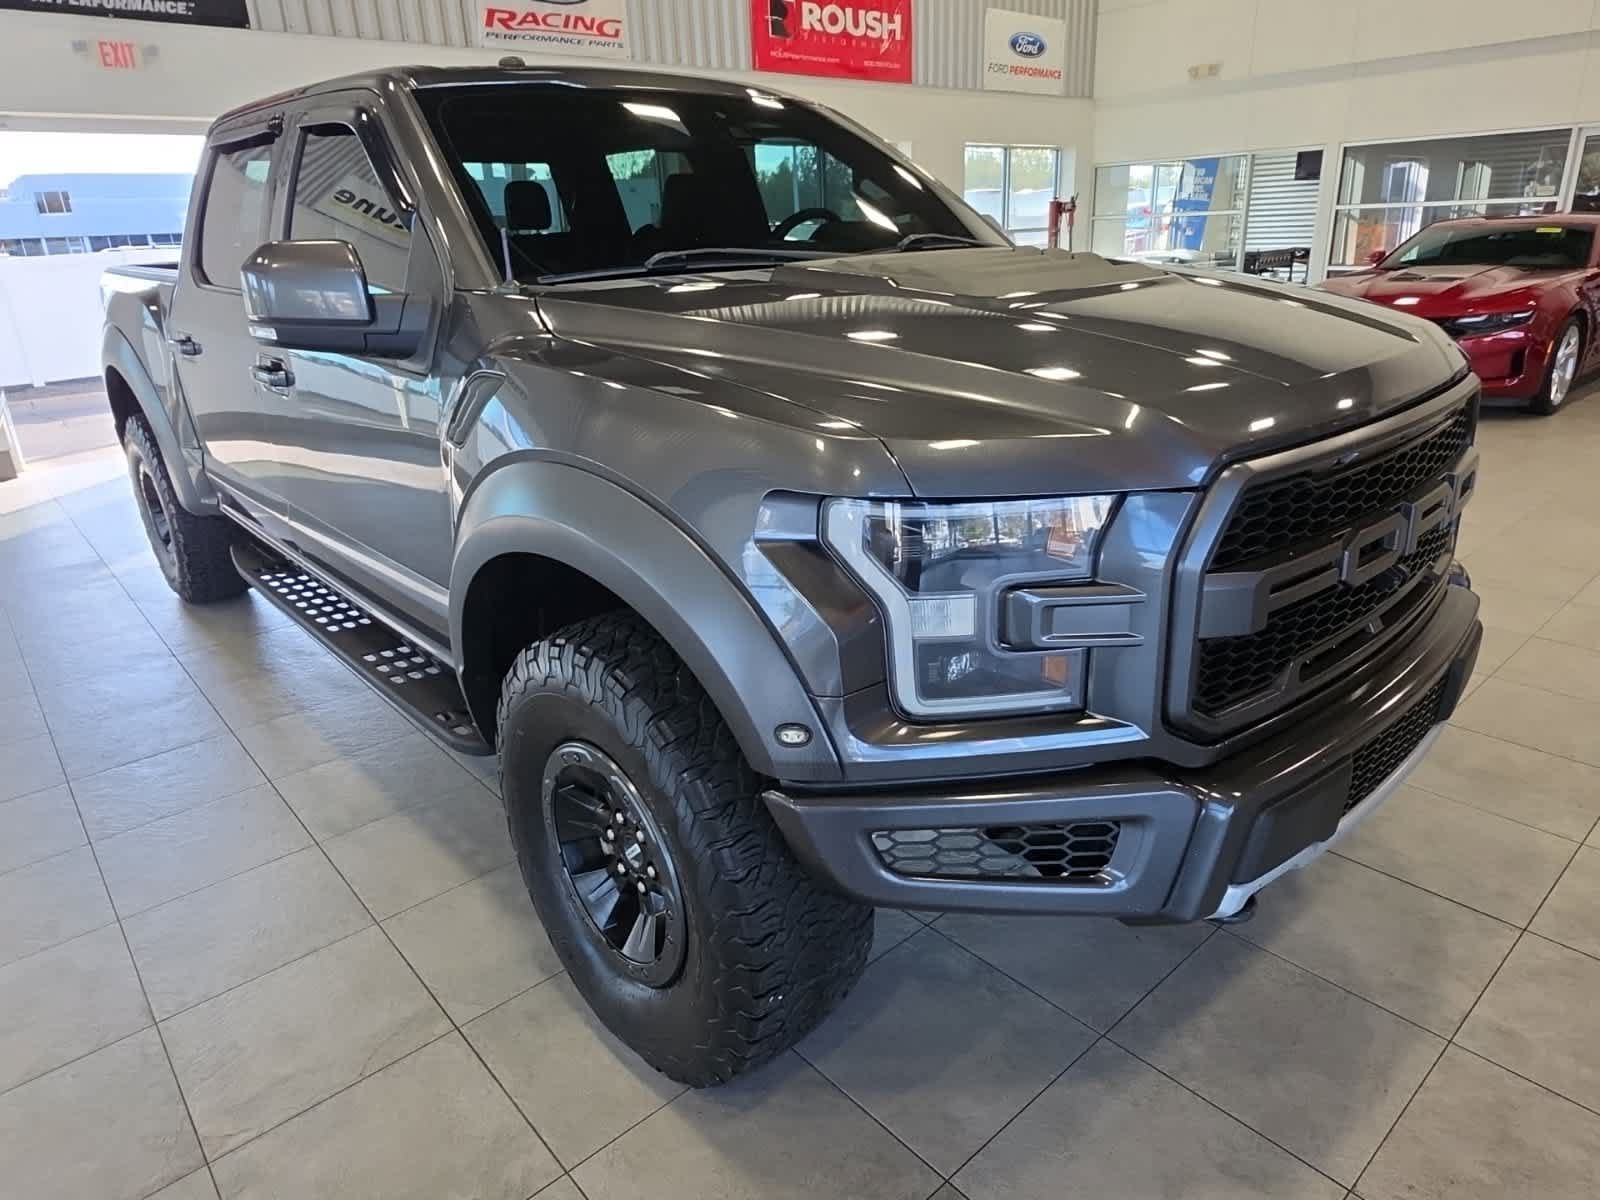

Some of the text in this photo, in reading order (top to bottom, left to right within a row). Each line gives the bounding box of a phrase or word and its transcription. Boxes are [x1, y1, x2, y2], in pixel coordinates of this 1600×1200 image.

[485, 8, 622, 39] RACING
[801, 1, 902, 41] ROUSH
[485, 31, 624, 49] PERFORMANCE PARTS
[1015, 35, 1041, 54] Ford
[98, 41, 136, 68] EXIT
[988, 62, 1062, 79] FORD PERFORMANCE
